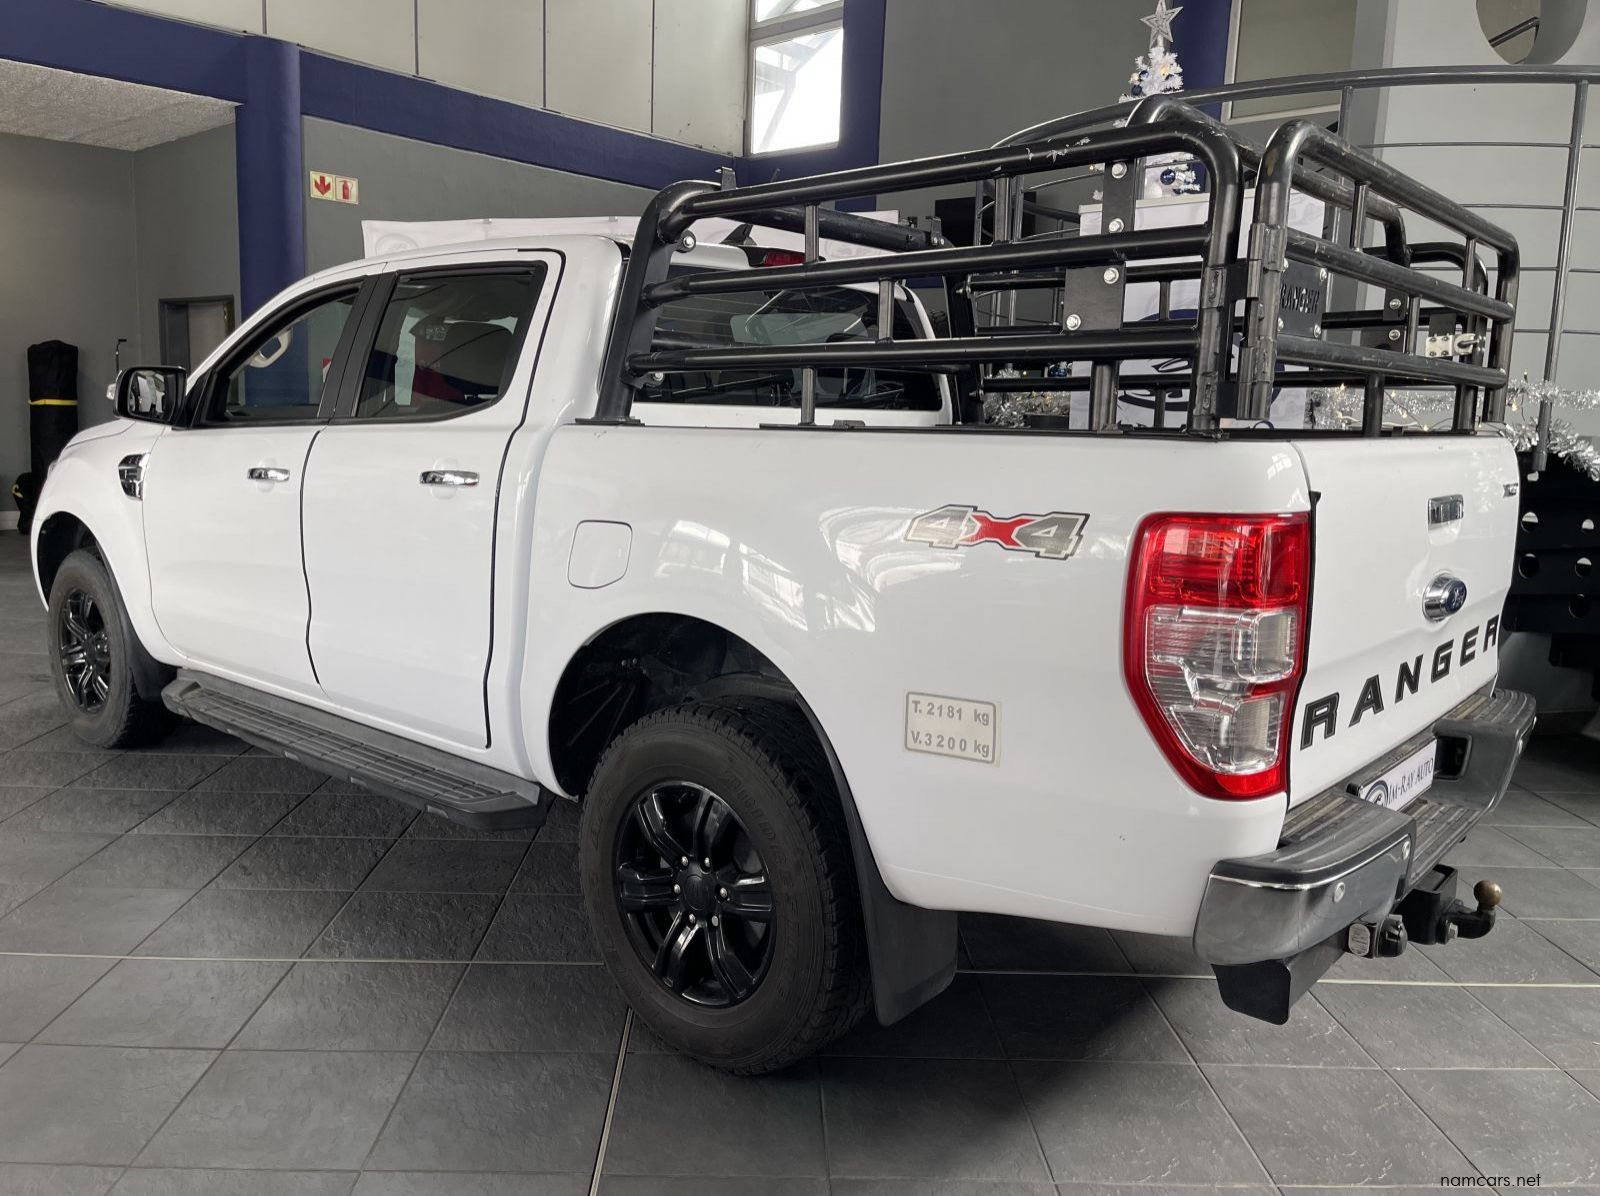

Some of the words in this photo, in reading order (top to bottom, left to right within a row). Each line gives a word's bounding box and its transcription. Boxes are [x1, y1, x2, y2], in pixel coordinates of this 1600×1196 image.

[1299, 614, 1500, 751] RANGER
[973, 708, 990, 727] kg
[973, 739, 990, 758] kg
[1415, 757, 1434, 784] AUTO
